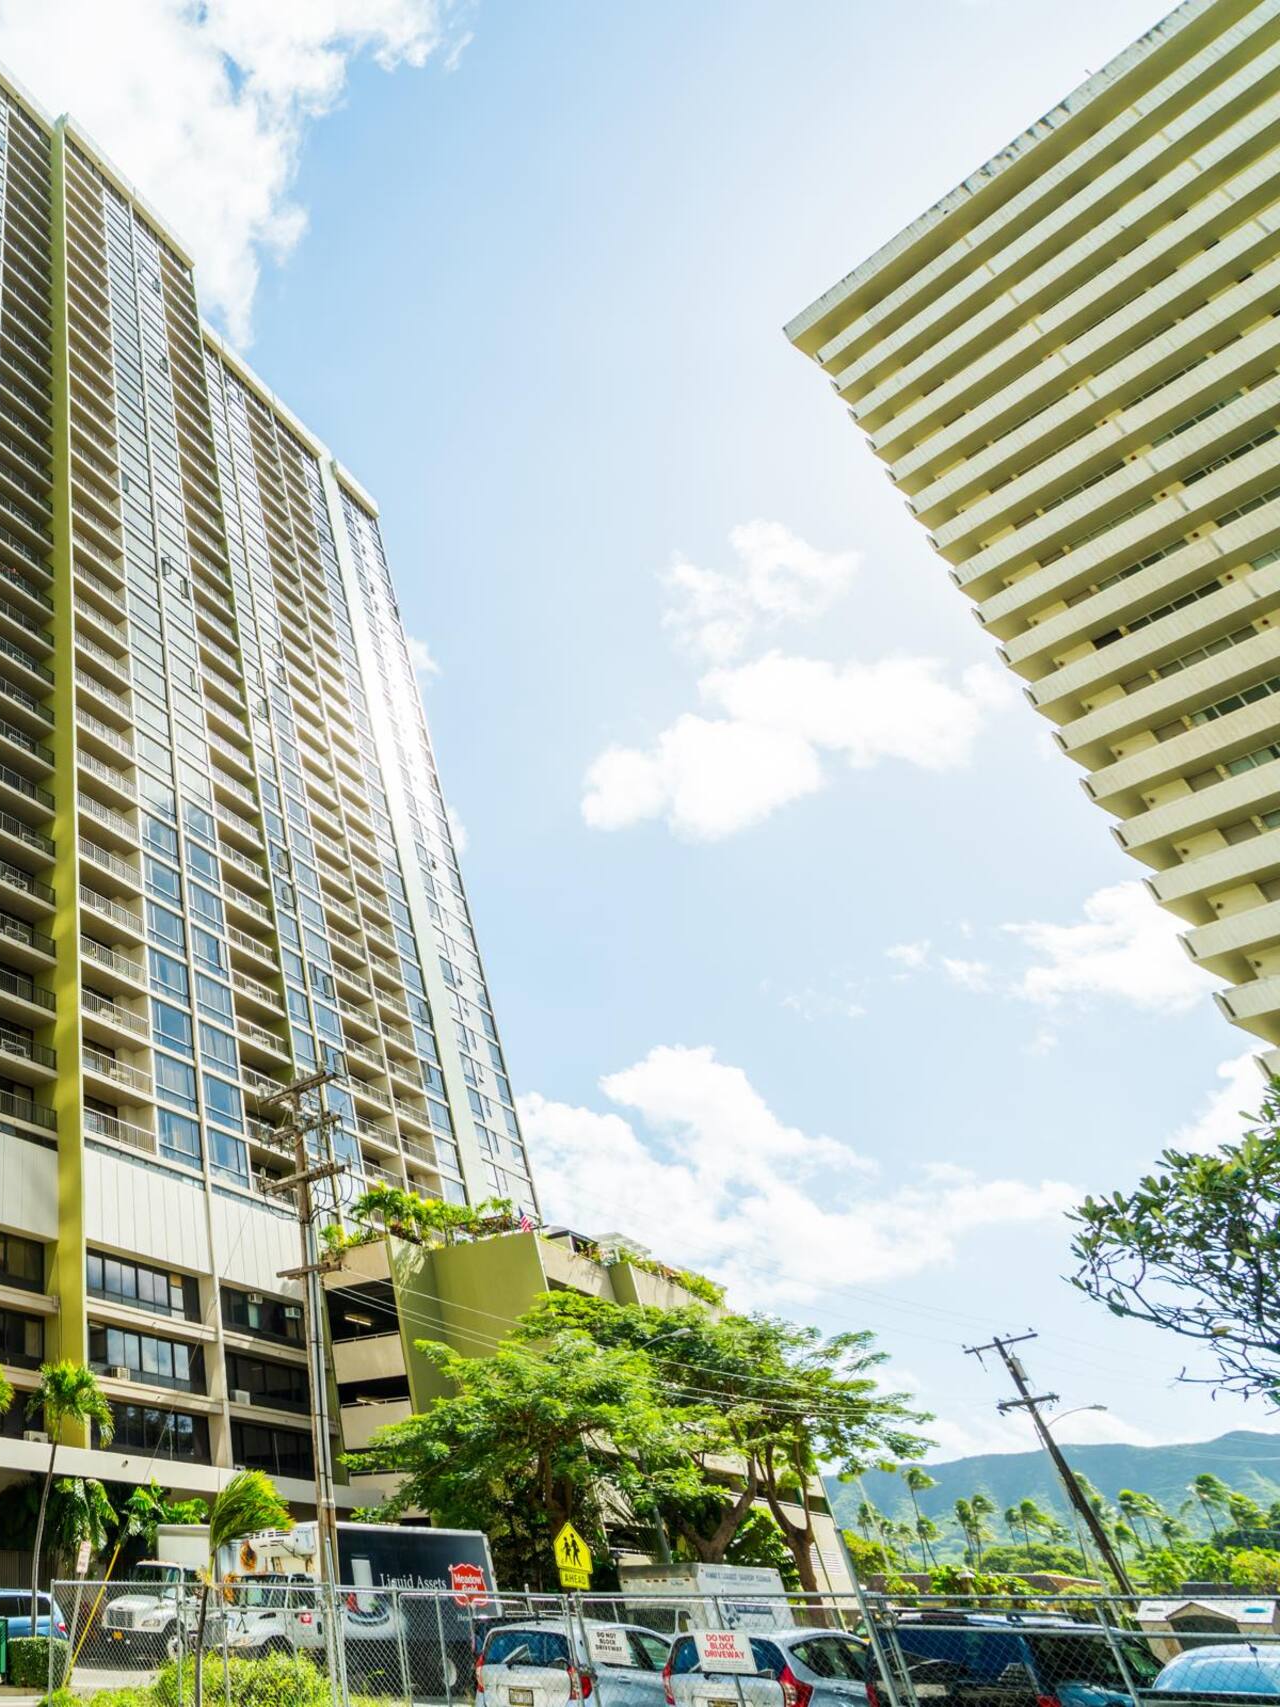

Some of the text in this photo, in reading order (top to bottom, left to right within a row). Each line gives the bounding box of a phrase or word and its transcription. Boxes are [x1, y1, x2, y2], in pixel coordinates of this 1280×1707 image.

[380, 1573, 447, 1590] Liquid Assets
[453, 1573, 482, 1585] Meadow
[564, 1572, 587, 1586] AHEAD
[599, 1638, 616, 1646] BLOCK
[705, 1633, 735, 1642] DO NOT
[595, 1644, 622, 1652] DRIVEWAY
[709, 1642, 736, 1650] BLOCK
[704, 1650, 745, 1659] DRIVEWAY
